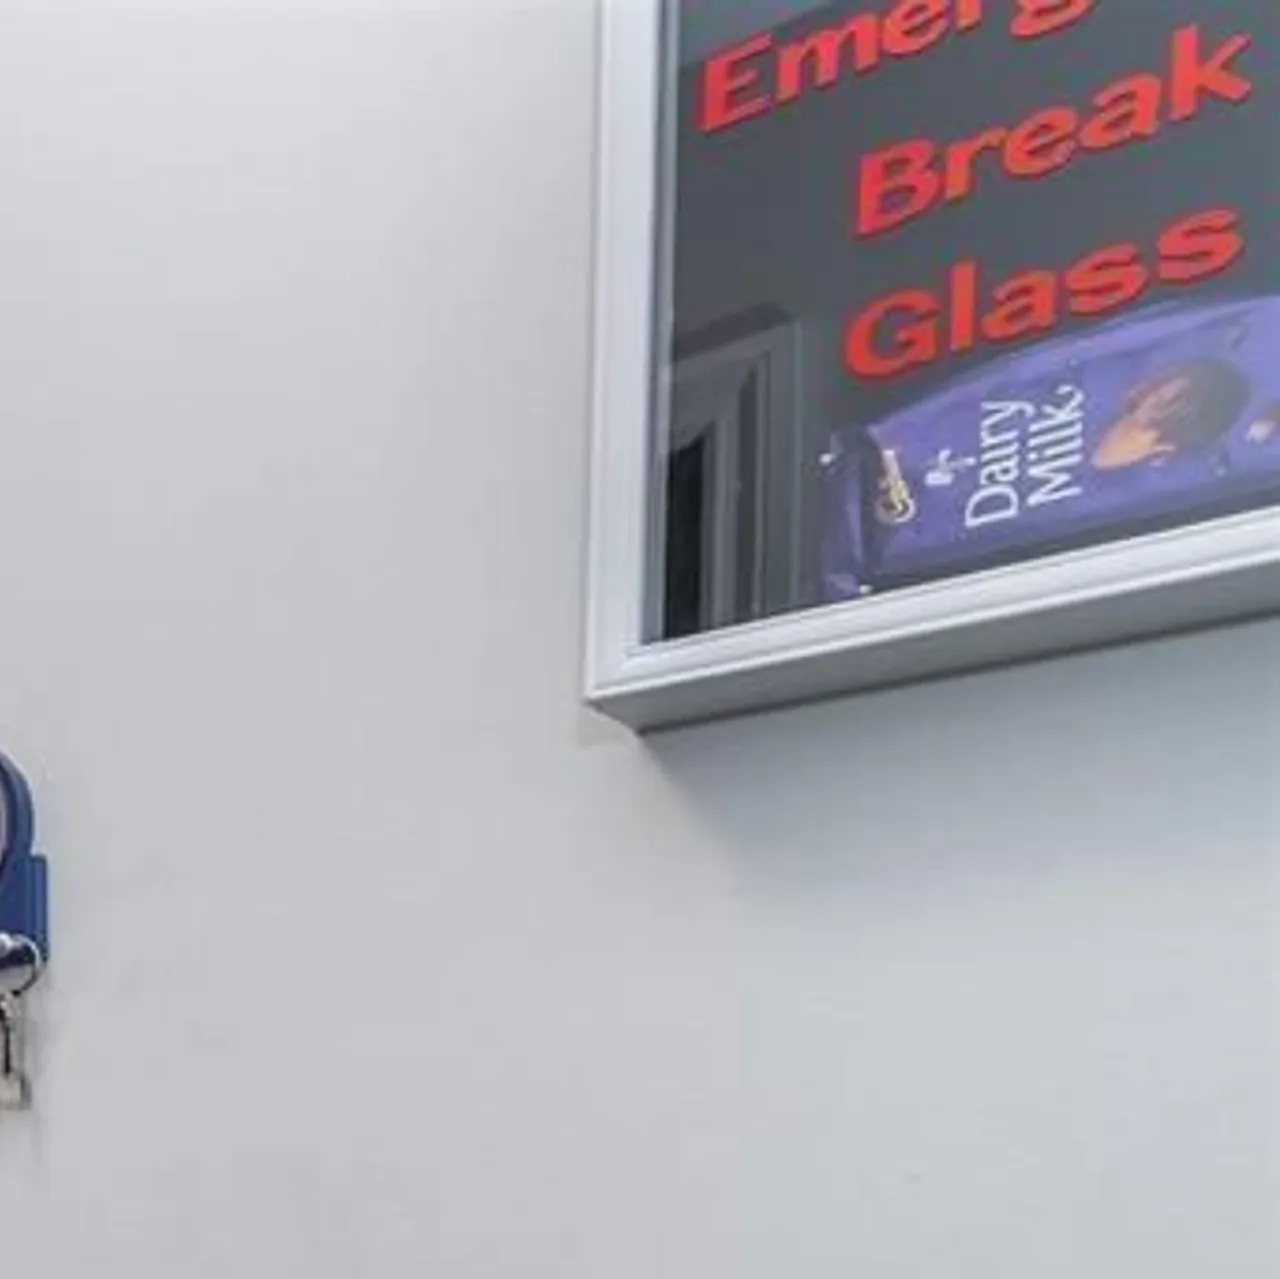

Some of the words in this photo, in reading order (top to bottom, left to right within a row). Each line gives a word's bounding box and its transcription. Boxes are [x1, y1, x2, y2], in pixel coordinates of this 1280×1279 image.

[856, 23, 1253, 236] Break
[844, 207, 1243, 378] Glass
[965, 399, 1034, 528] Dairy
[1027, 383, 1085, 508] Milk
